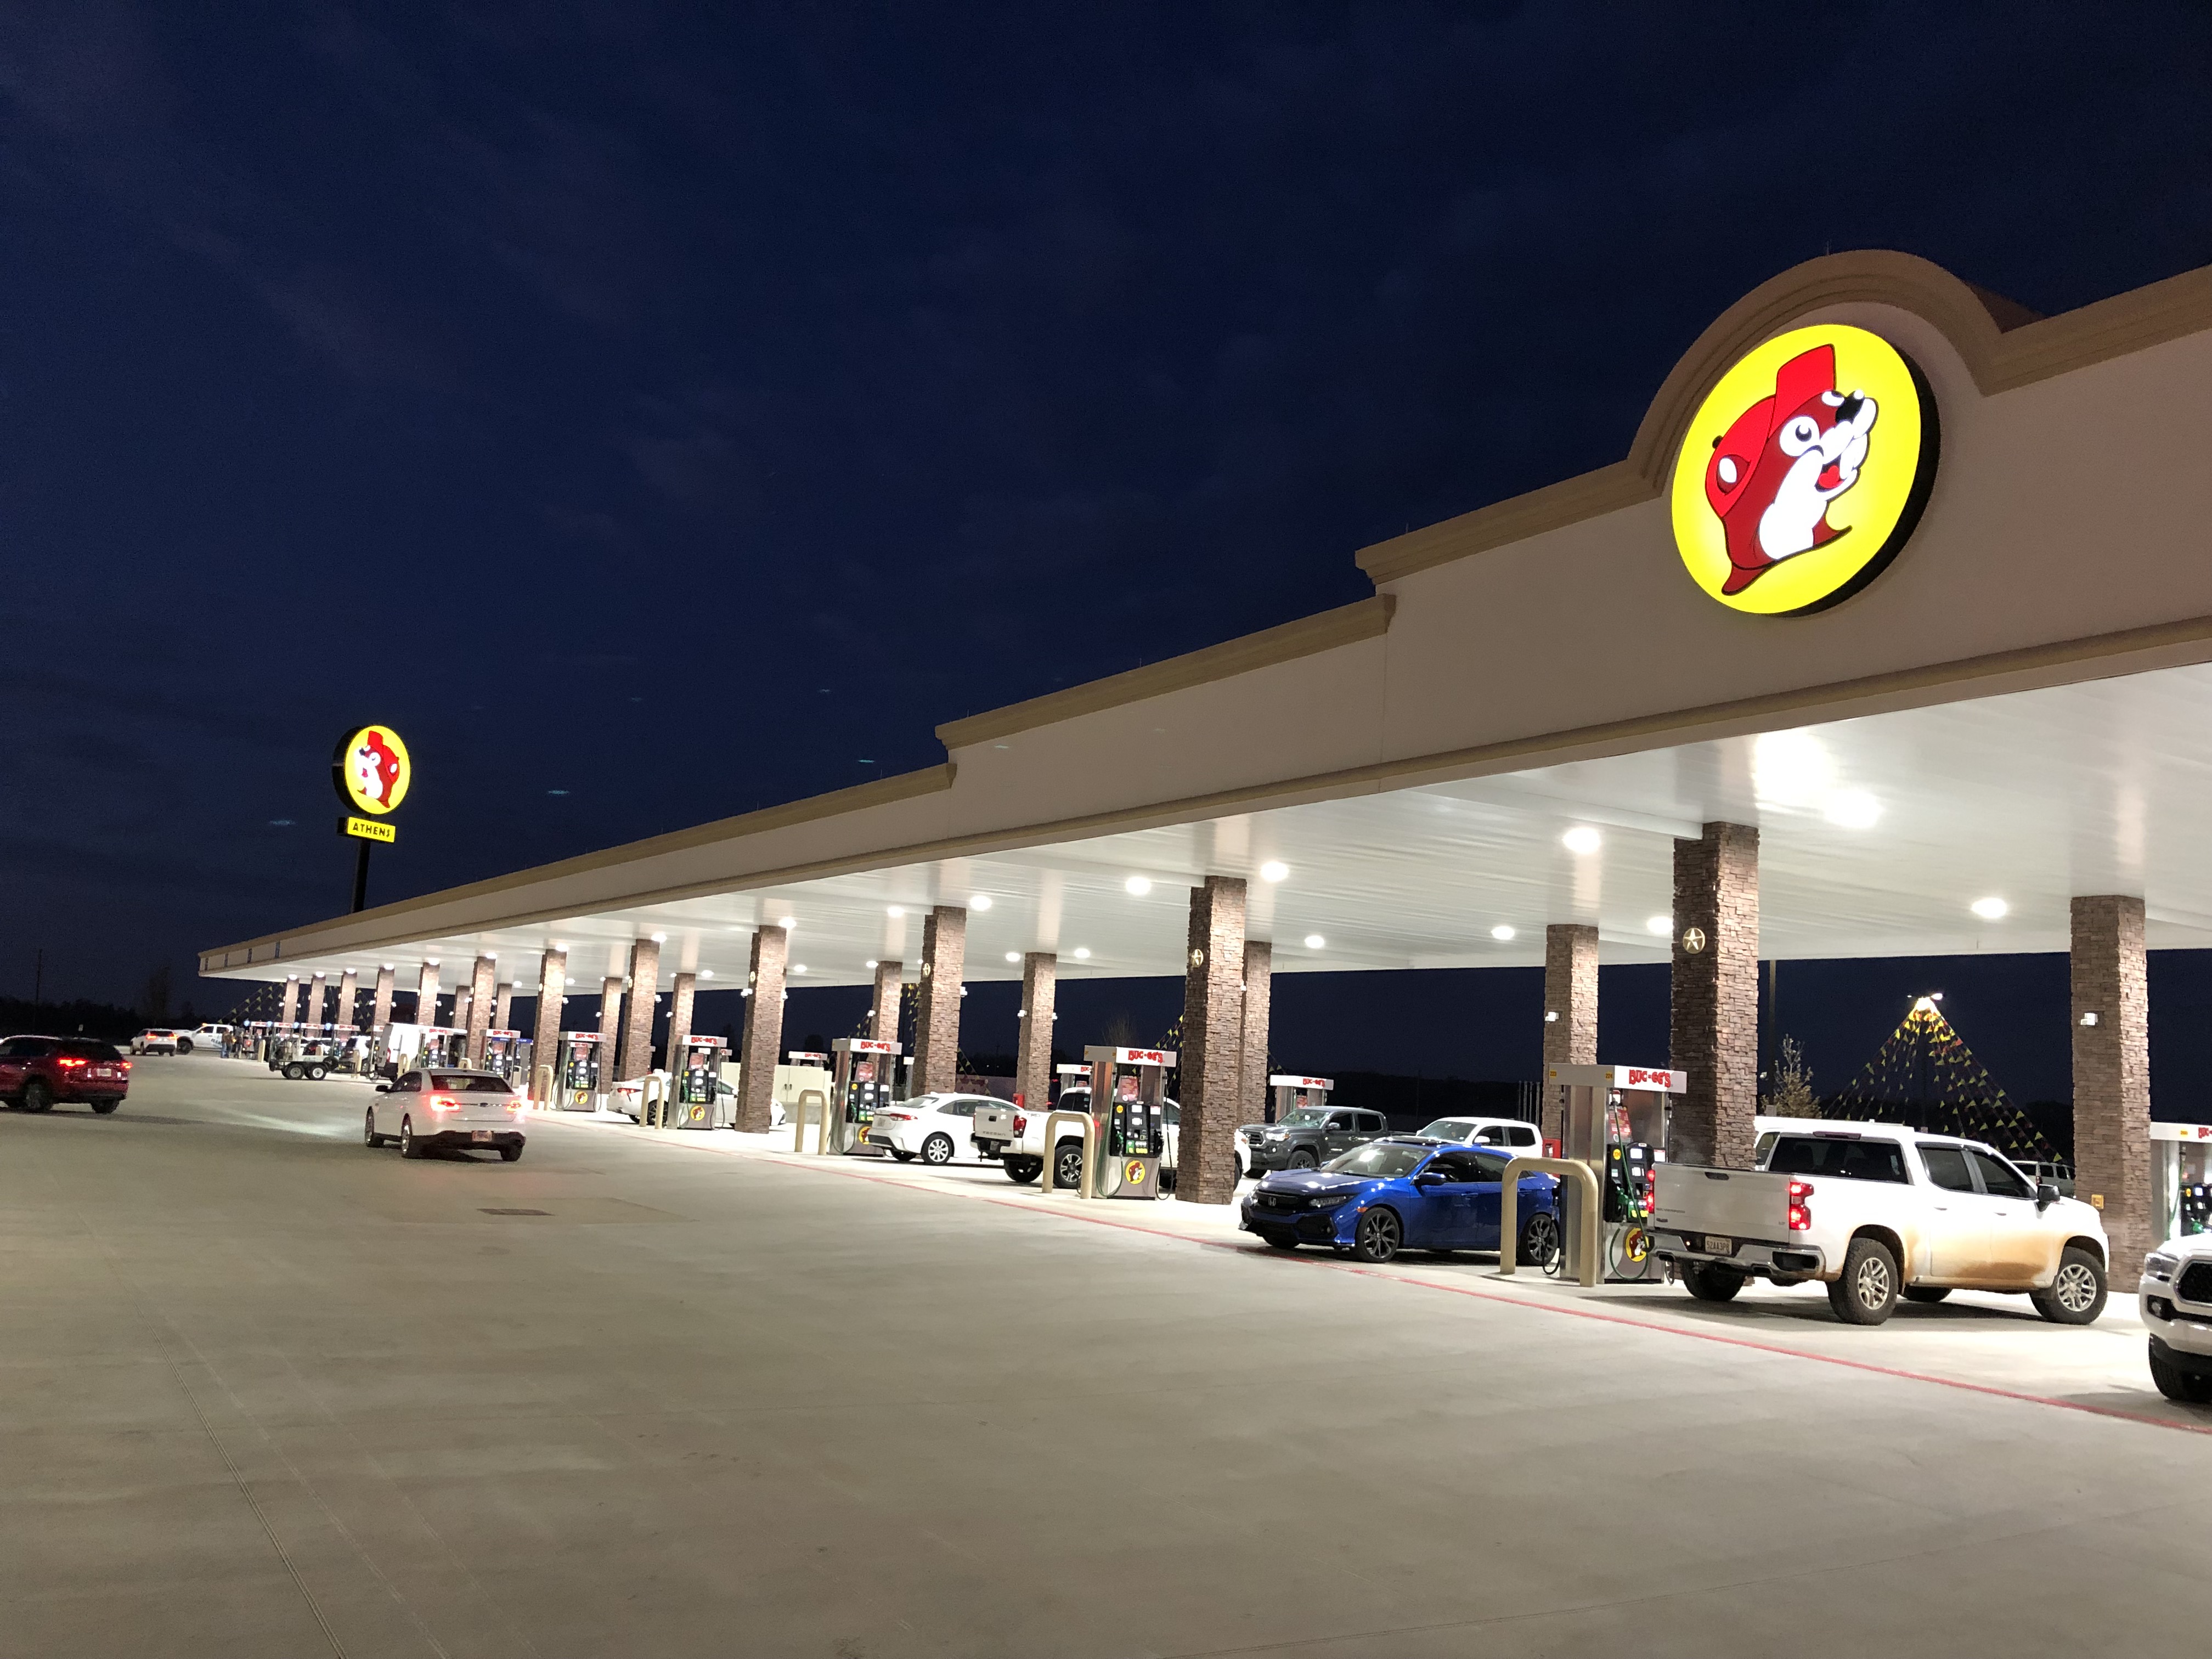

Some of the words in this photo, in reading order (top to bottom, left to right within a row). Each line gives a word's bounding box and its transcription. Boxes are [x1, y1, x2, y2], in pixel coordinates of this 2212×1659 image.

[353, 822, 390, 838] ATHENS
[1128, 1050, 1163, 1063] BUC-EE'S
[1629, 1069, 1671, 1088] BUC-EE'S
